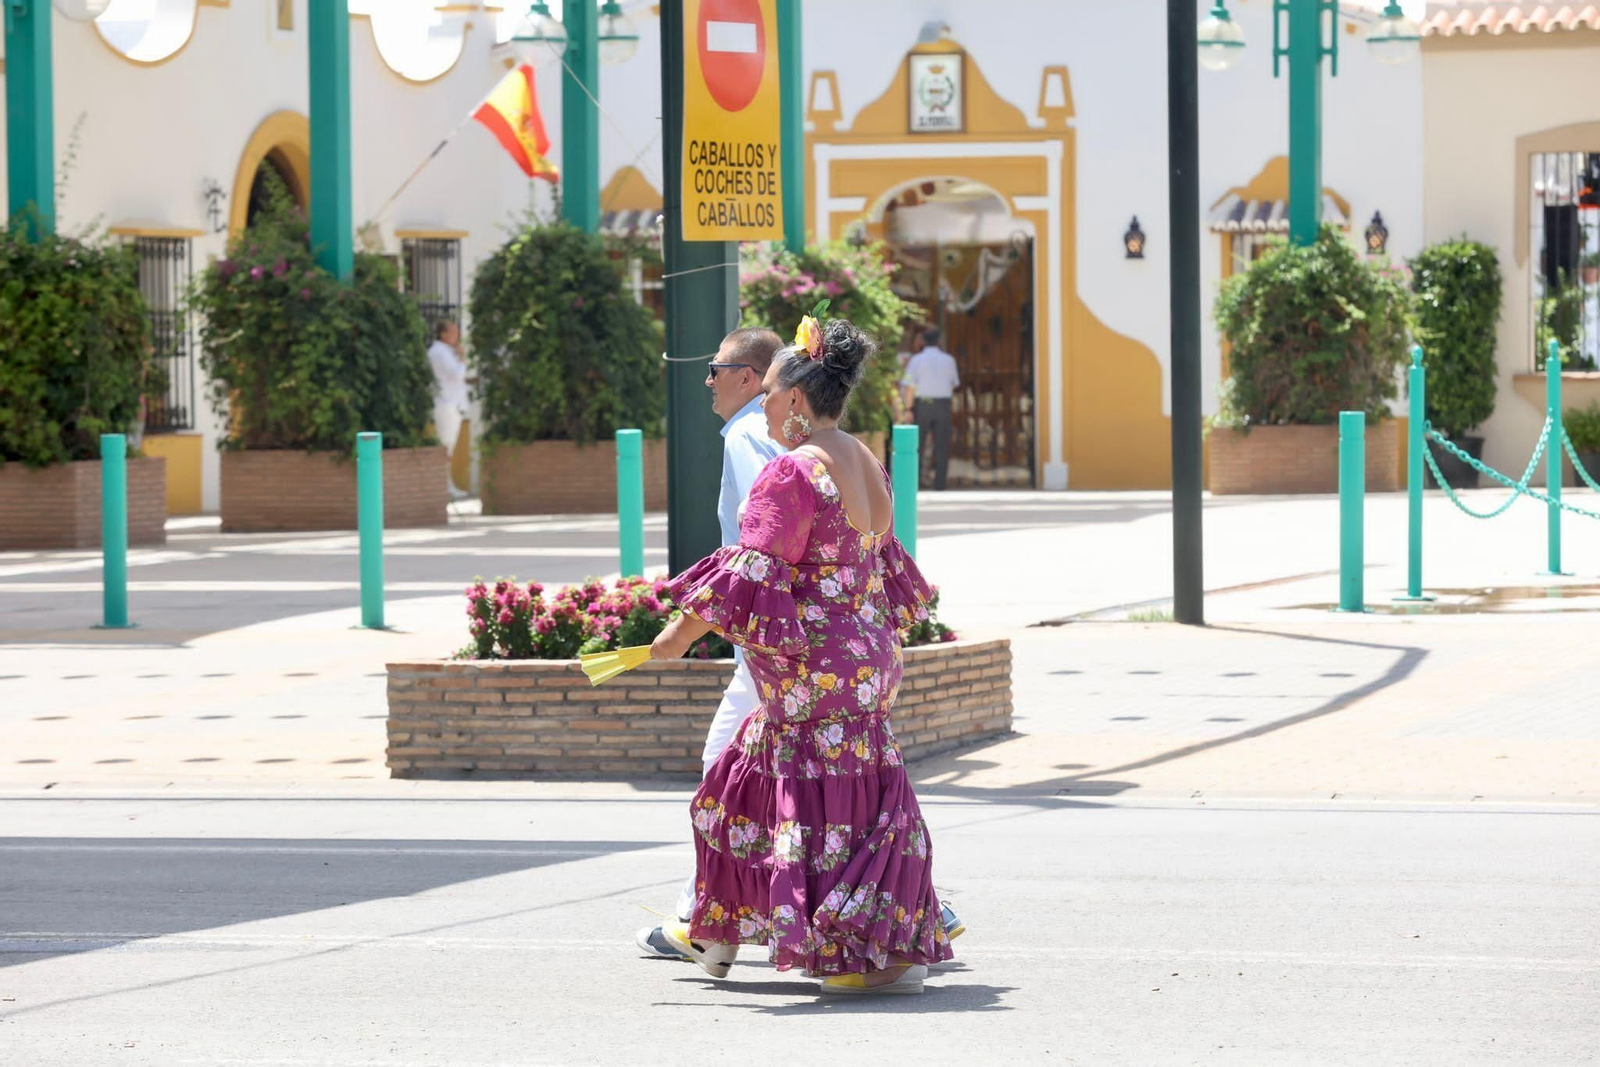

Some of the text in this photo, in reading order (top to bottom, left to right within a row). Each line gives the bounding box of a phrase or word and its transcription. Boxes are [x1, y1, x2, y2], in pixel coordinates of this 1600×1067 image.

[689, 139, 777, 168] CABALLOS Y
[694, 168, 776, 195] COCHES DE
[697, 201, 774, 227] CABALLOS
